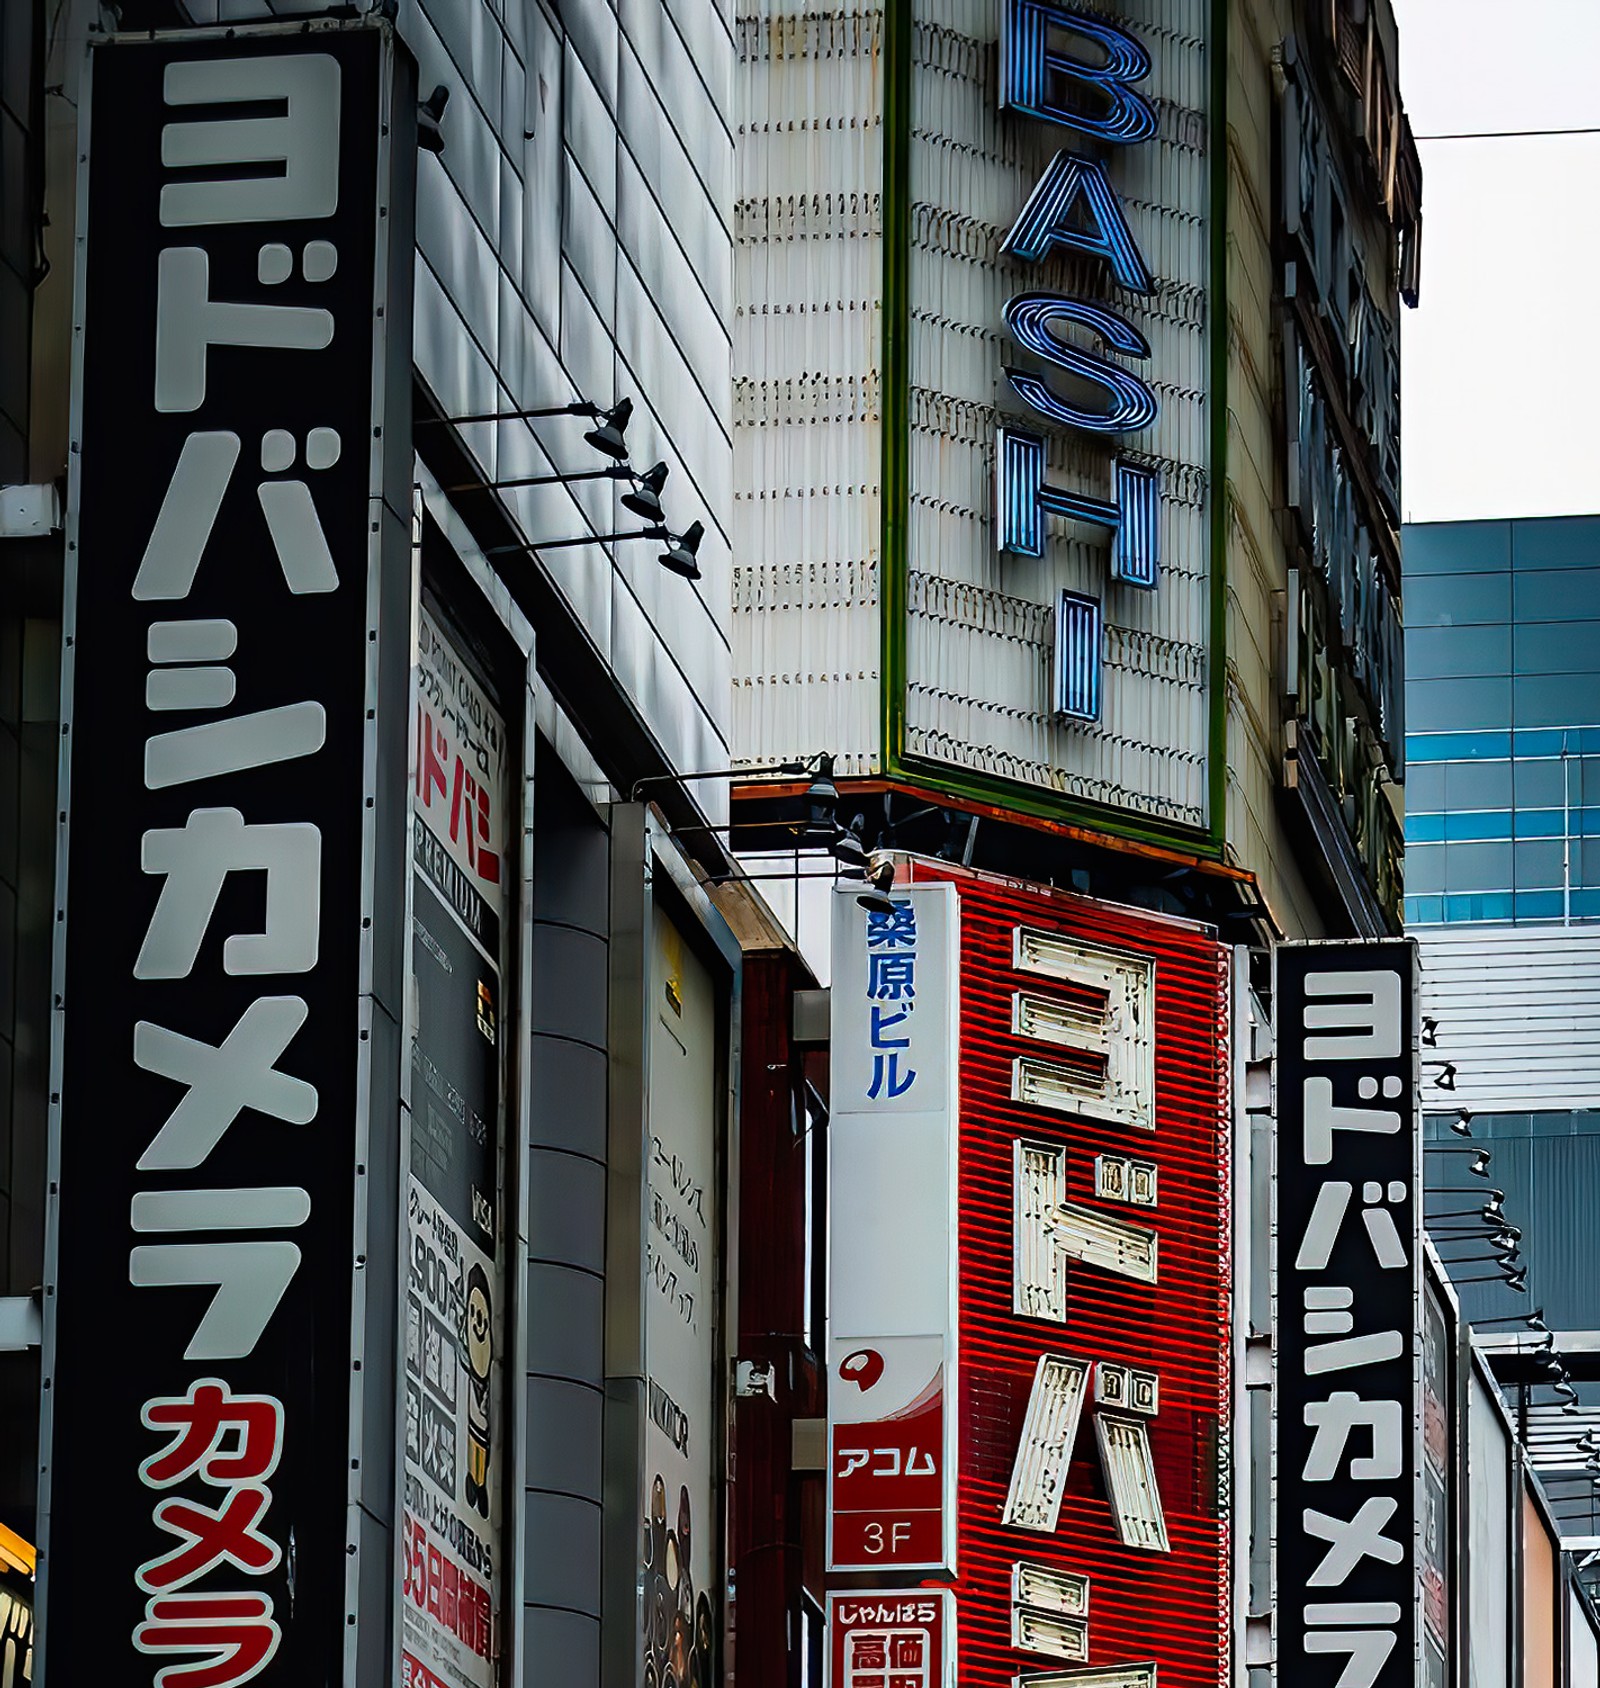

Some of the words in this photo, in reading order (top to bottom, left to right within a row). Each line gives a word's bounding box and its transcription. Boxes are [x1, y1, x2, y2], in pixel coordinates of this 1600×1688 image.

[998, 0, 1159, 723] BASHI
[130, 53, 343, 1360] ヨドバシカメラ
[867, 898, 917, 1100] 桑原ビル
[838, 1448, 937, 1478] アコム
[863, 1522, 912, 1555] 3F
